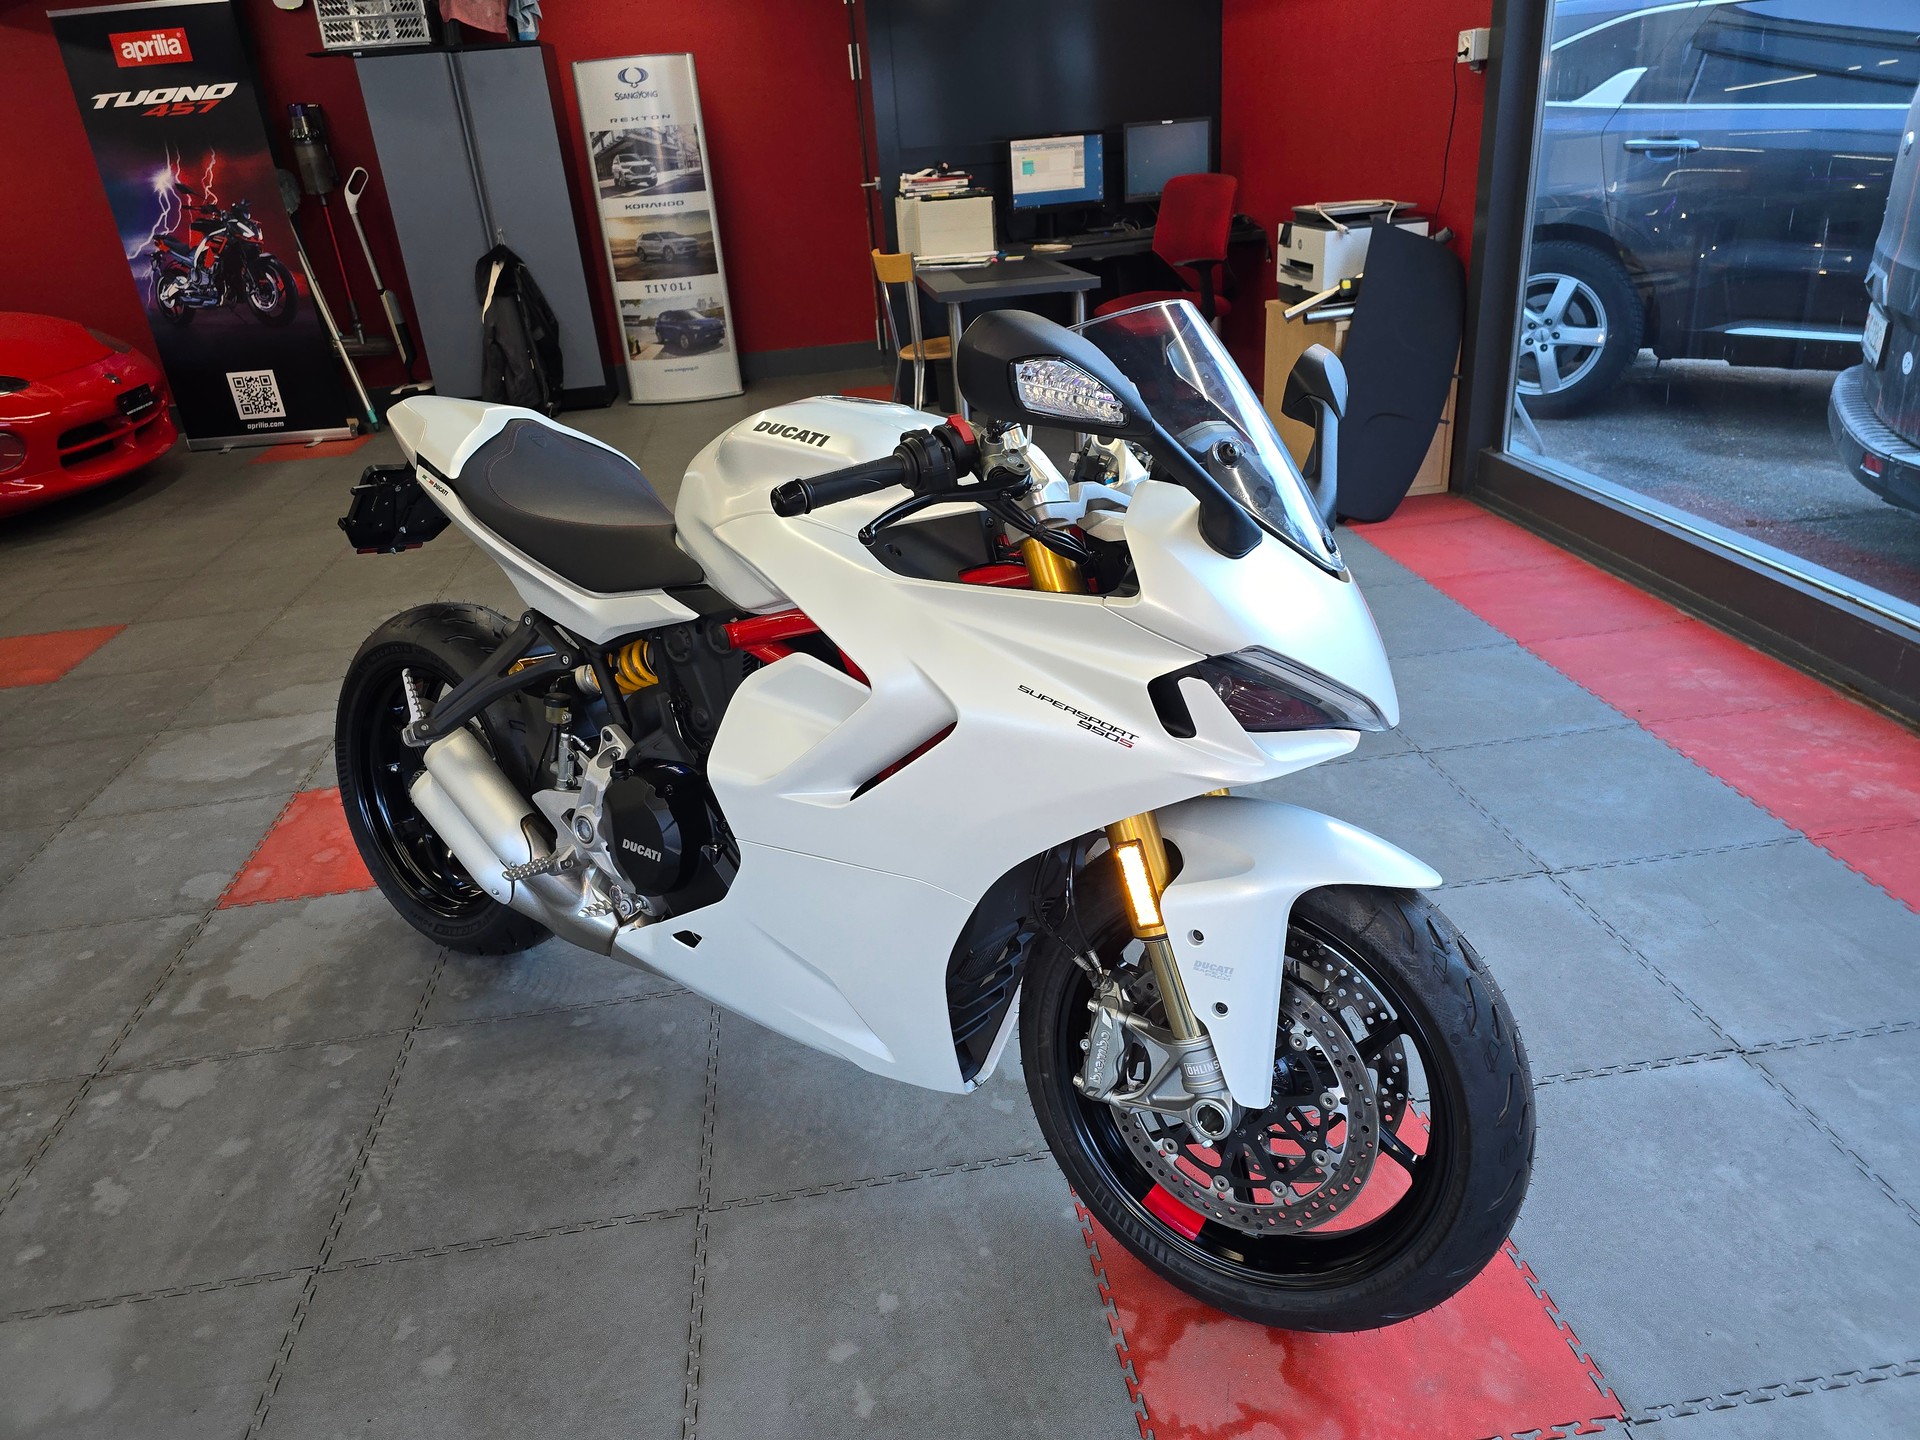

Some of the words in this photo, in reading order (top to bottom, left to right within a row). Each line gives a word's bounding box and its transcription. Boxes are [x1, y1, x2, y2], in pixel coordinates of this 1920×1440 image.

[120, 33, 182, 62] aprilia
[91, 82, 238, 109] TUONO
[142, 99, 222, 117] 457
[609, 113, 671, 124] REXTON
[624, 200, 685, 210] KORANDO
[644, 281, 693, 294] TIVOLI
[247, 421, 285, 430] aprilia.com
[752, 420, 831, 448] DUCATI
[433, 482, 449, 496] DUCATI
[1017, 684, 1140, 740] SUPERSPORT
[1077, 719, 1135, 749] 950S
[622, 838, 662, 863] DUCATI
[1193, 959, 1234, 975] DUCATI
[1090, 1030, 1110, 1084] brembo
